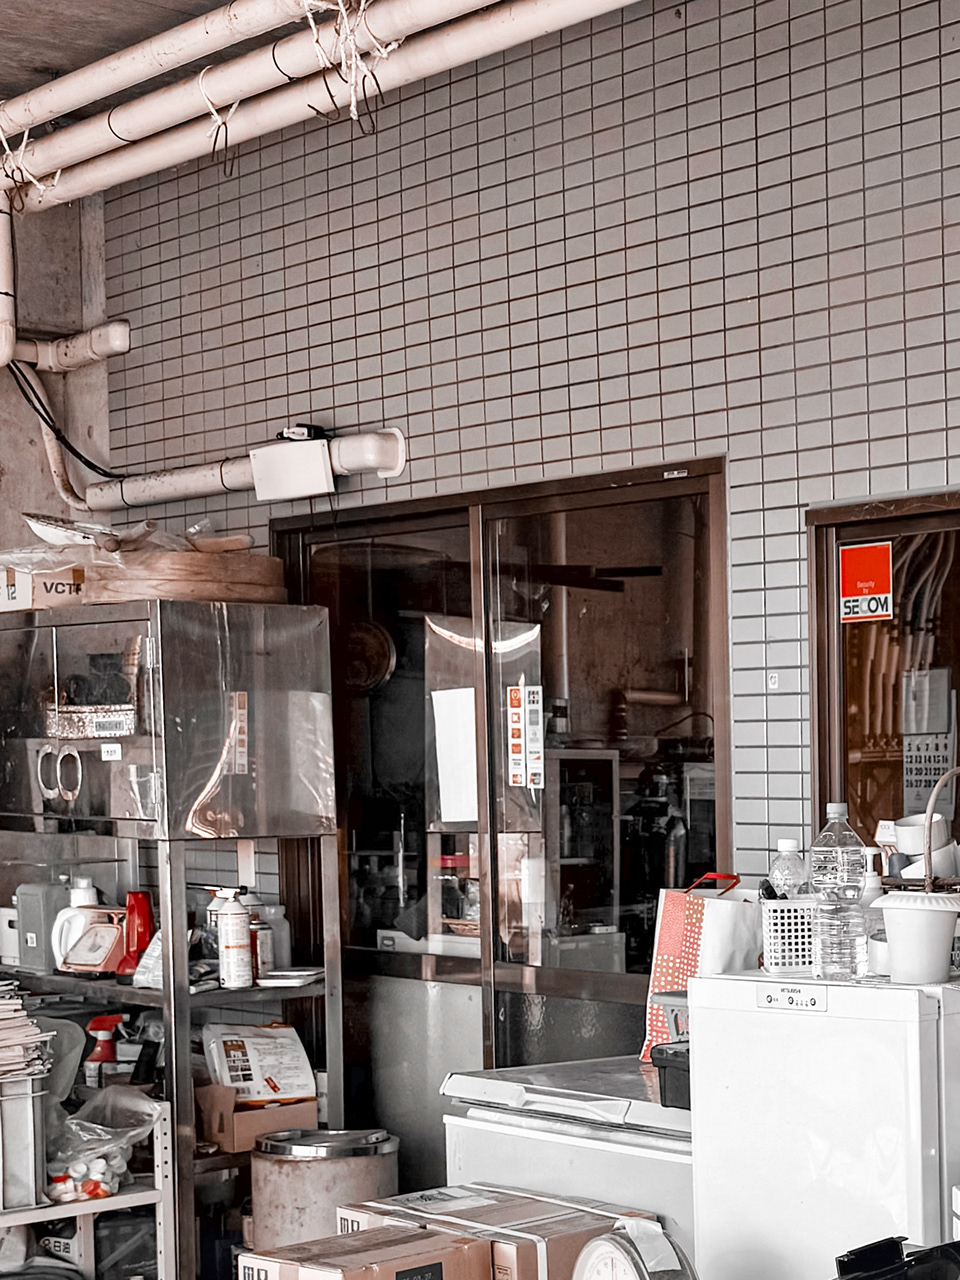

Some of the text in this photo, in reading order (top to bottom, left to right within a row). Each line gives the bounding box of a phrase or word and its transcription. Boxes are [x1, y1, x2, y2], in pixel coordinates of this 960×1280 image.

[843, 596, 889, 615] SECOM
[907, 742, 948, 752] 5 6 7 8 9
[905, 755, 949, 764] 12 13 14 15 16
[905, 767, 914, 776] 19
[914, 767, 923, 776] 20
[924, 767, 932, 776] 21
[933, 767, 941, 776] 22
[905, 779, 914, 788] 26
[915, 779, 923, 788] 27
[924, 779, 932, 788] 28
